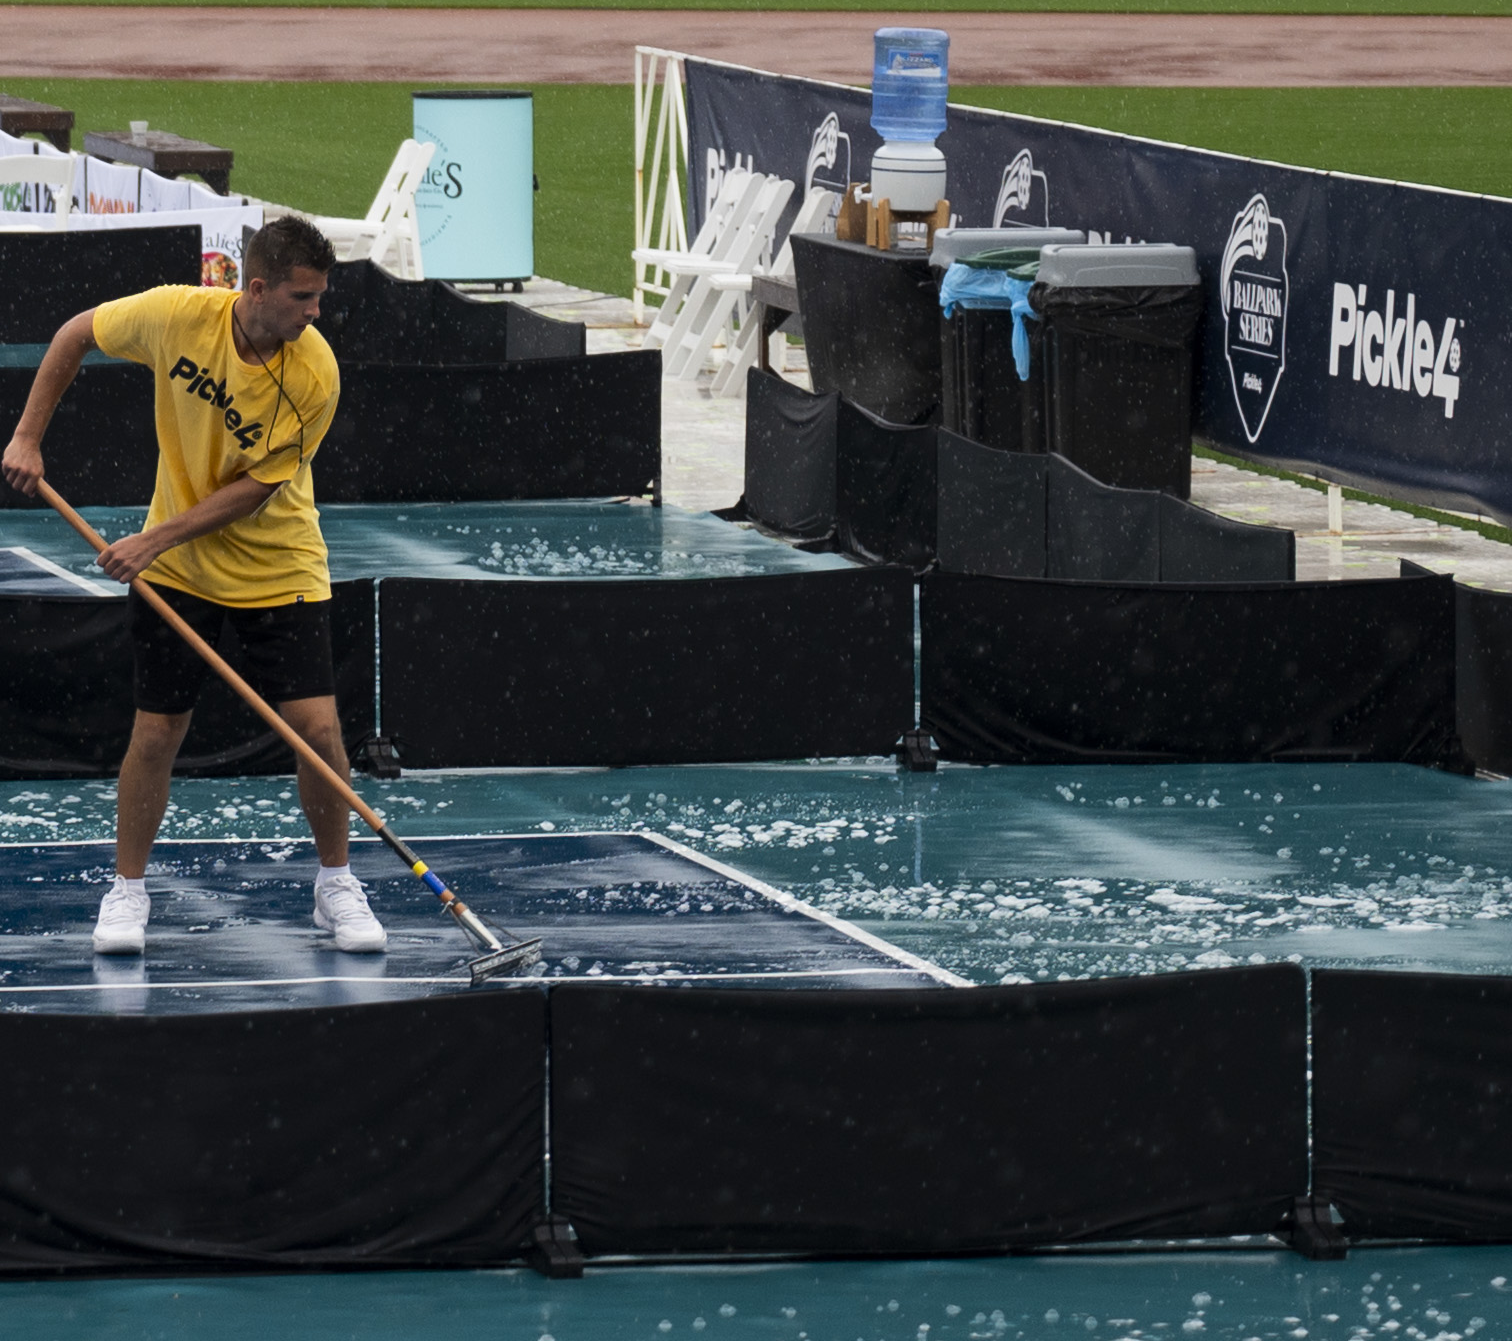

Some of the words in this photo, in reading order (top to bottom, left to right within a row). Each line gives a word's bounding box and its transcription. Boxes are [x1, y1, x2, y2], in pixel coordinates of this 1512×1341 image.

[1233, 279, 1282, 319] BALLPARK
[1238, 312, 1274, 347] SERIES
[1329, 282, 1461, 418] Pickle4
[169, 356, 263, 450] Pickle4
